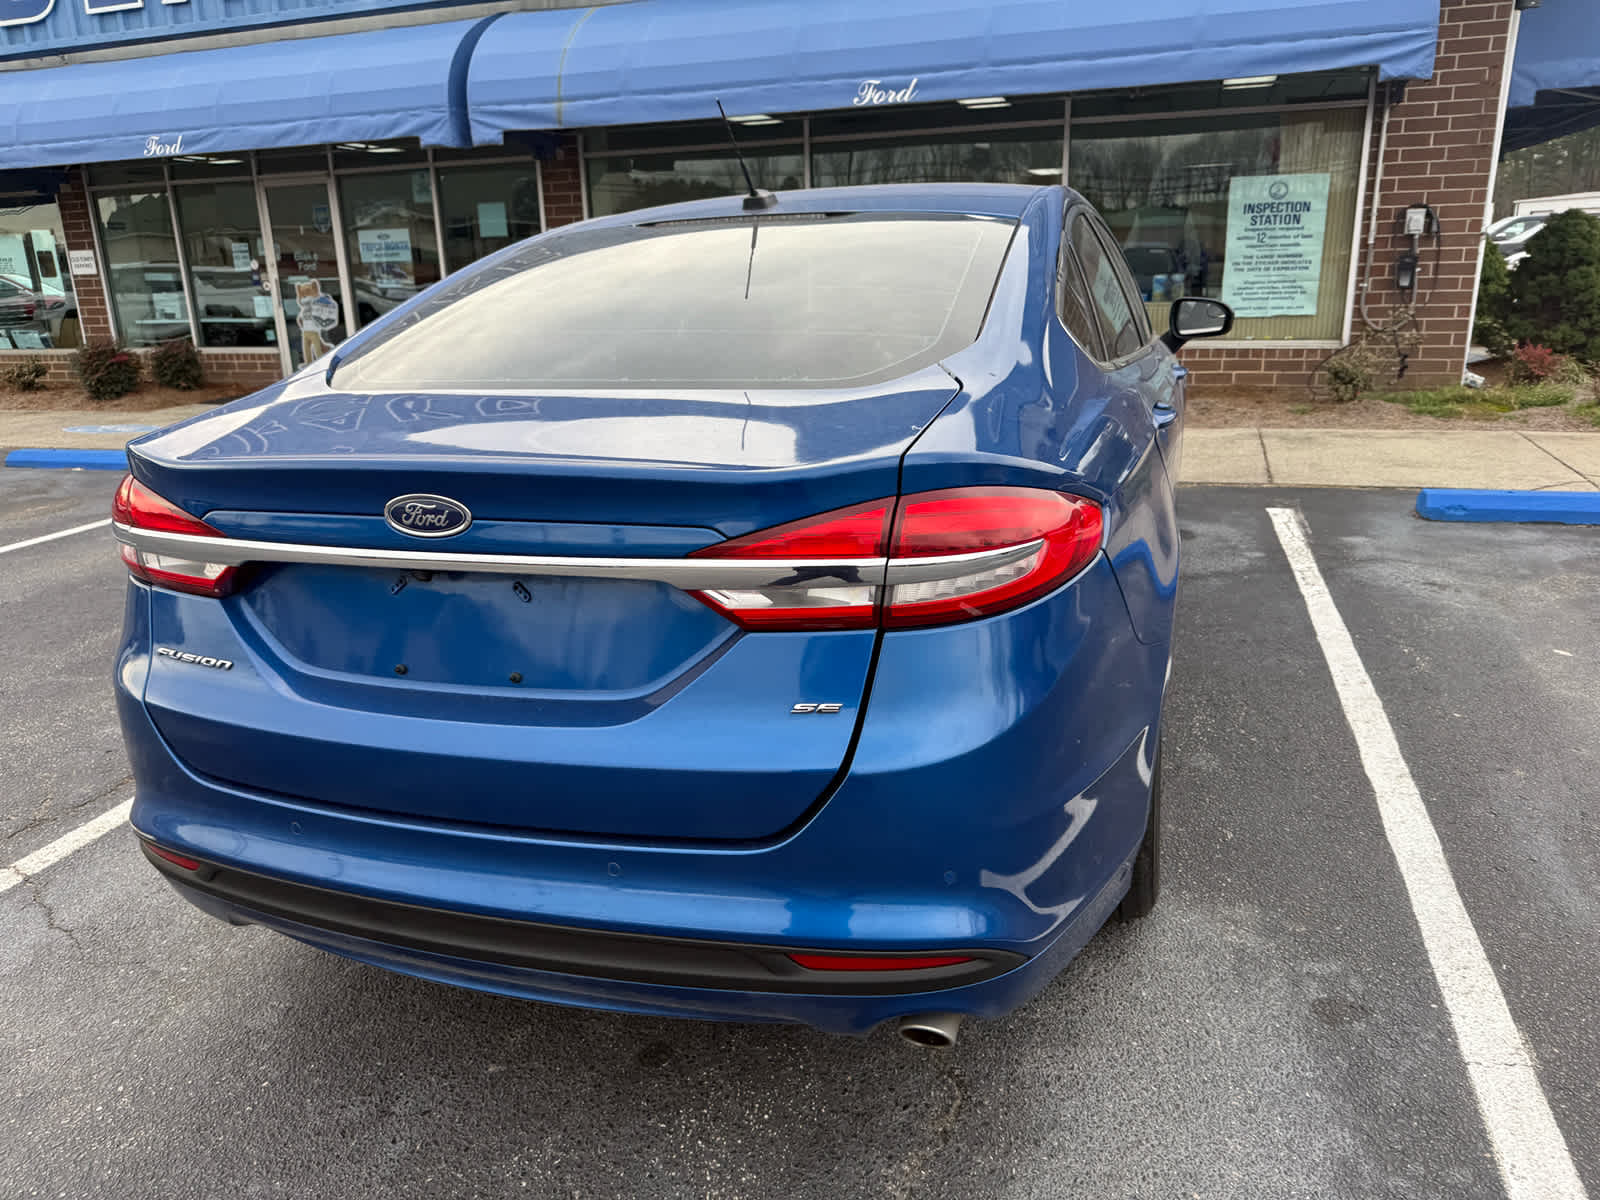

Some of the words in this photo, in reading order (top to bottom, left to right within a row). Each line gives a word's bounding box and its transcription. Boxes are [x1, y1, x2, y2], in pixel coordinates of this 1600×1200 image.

[853, 77, 919, 106] Ford
[143, 135, 184, 157] Ford
[1243, 201, 1312, 215] INSPECTION
[1250, 214, 1302, 226] STATION
[1256, 232, 1267, 243] 12
[402, 502, 449, 527] Ford
[790, 703, 844, 714] SE
